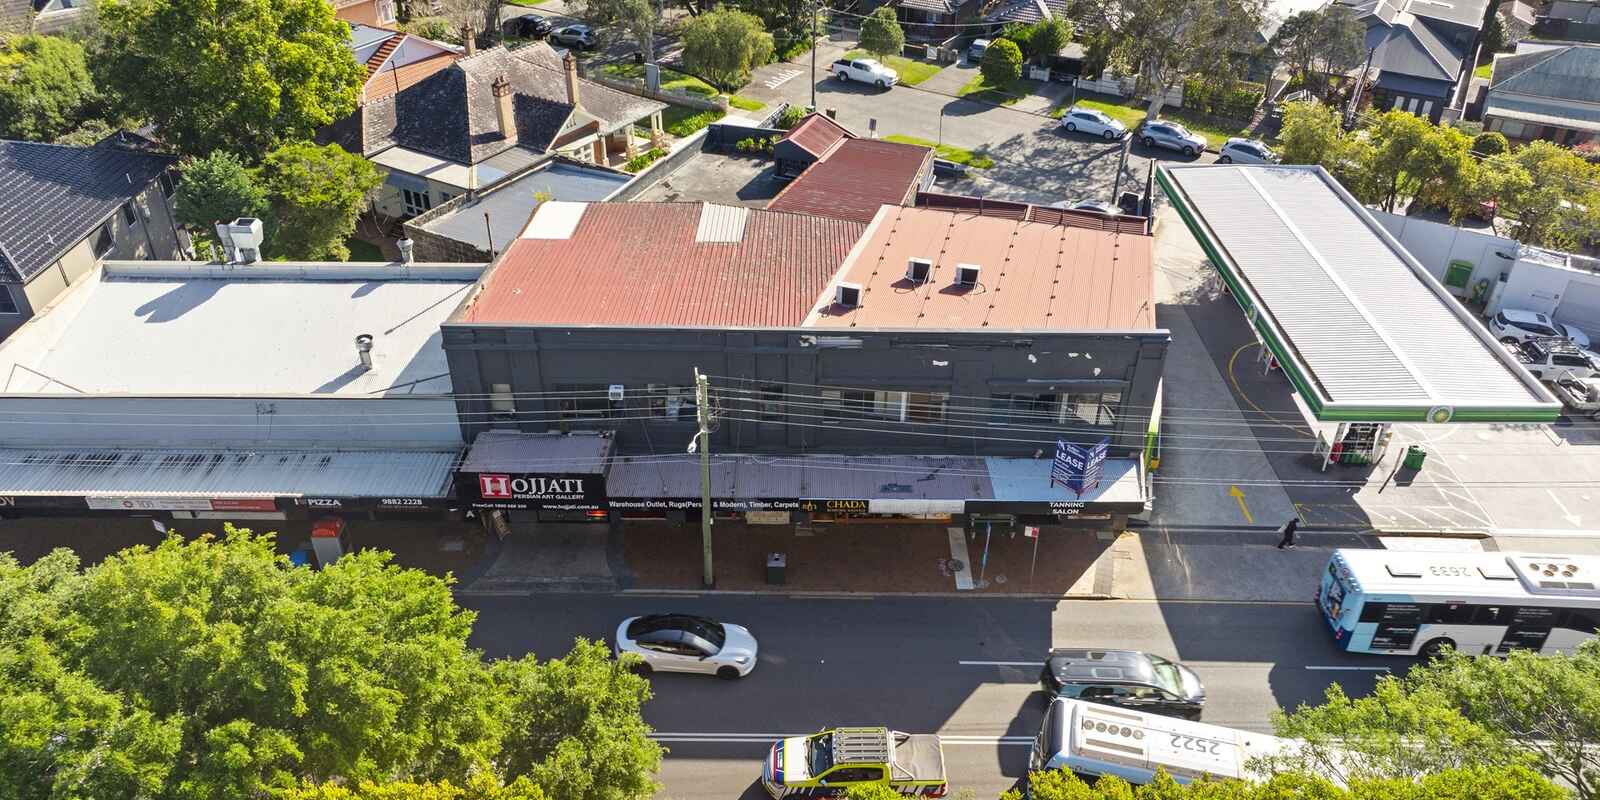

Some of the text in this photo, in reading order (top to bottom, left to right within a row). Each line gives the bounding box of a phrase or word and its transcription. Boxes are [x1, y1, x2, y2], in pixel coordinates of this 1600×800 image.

[1056, 449, 1083, 471] LEASE
[481, 476, 584, 496] HOJJATI
[307, 498, 342, 506] PIZZA
[608, 500, 645, 508] Warehouse
[646, 500, 668, 508] Outlet,
[669, 501, 704, 509] Rugs(Pers
[748, 501, 773, 509] Timber,
[773, 501, 799, 509] Carpets
[826, 500, 866, 509] CHADA
[1429, 566, 1472, 577] 2633
[1170, 733, 1221, 756] 2522
